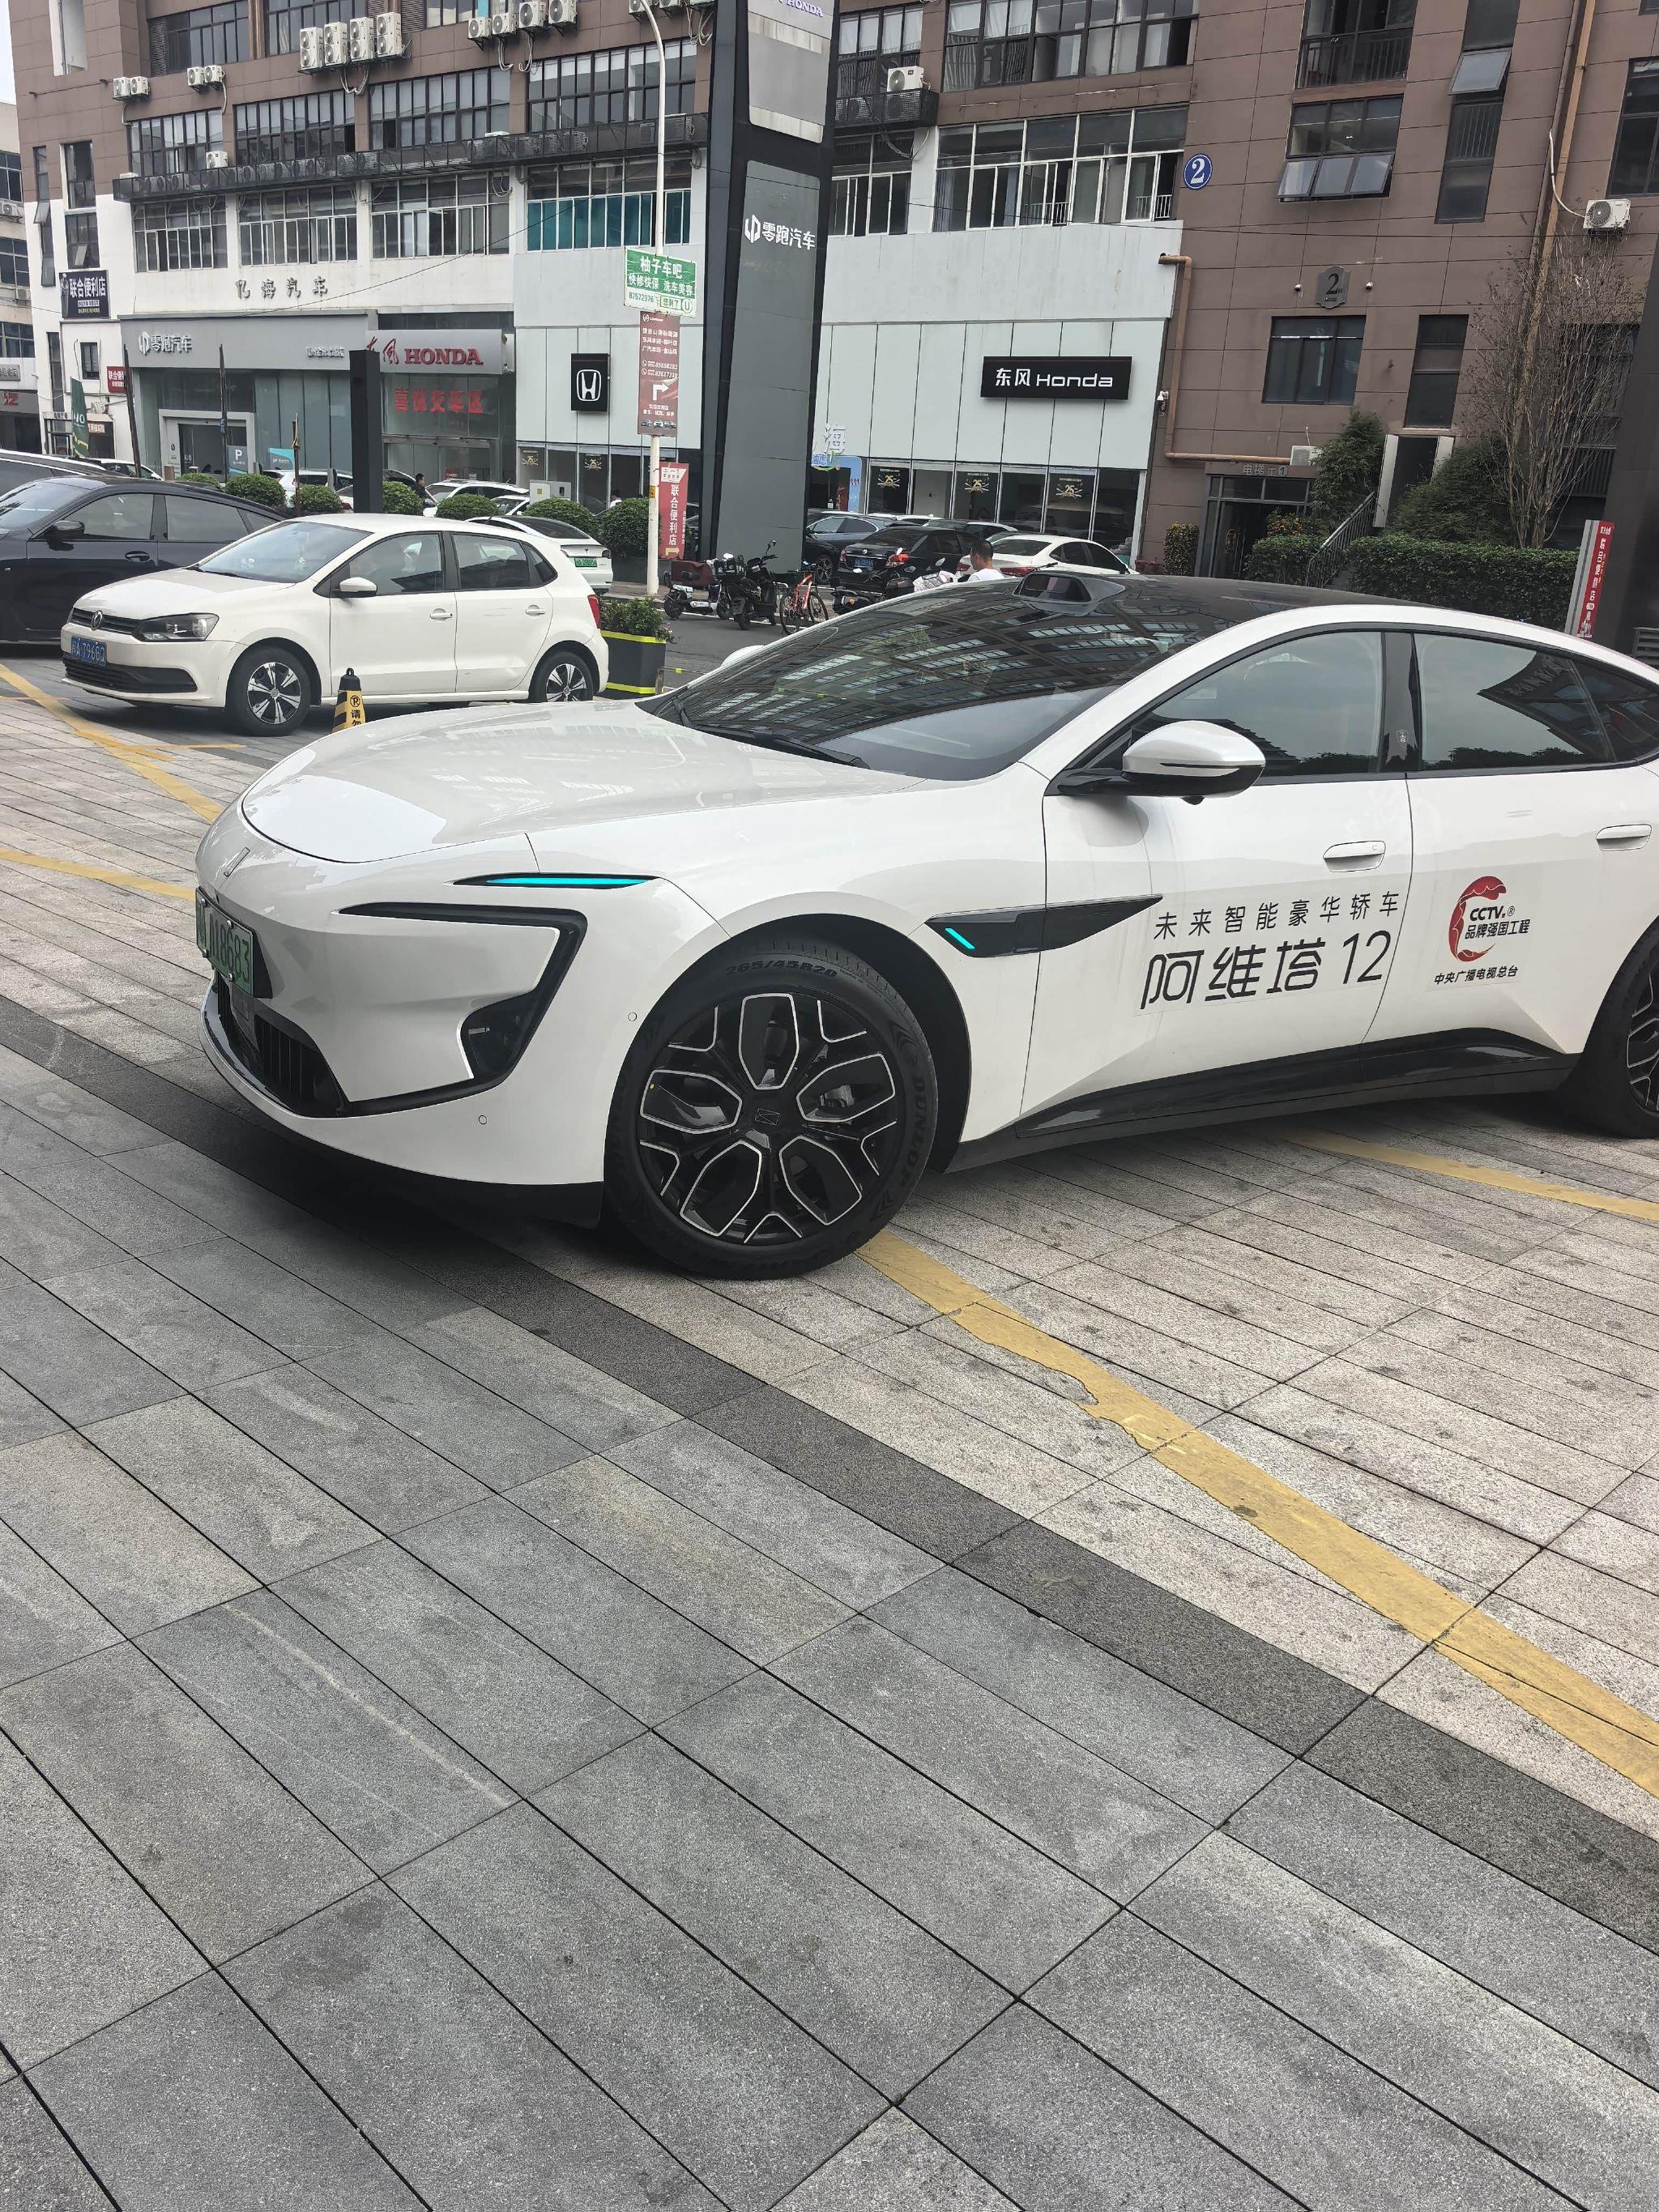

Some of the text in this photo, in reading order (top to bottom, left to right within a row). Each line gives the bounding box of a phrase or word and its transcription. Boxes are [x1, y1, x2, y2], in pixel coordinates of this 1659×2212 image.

[786, 0, 823, 17] HONDA
[1191, 158, 1205, 184] 2
[762, 221, 816, 250] 零跑汽车
[640, 255, 683, 279] 柚子车吧
[69, 276, 106, 298] 联合便利店
[235, 275, 328, 300] 亿海汽车
[628, 273, 693, 296] 快修快保 洗车美容
[1326, 273, 1339, 295] 2
[150, 335, 193, 353] 零跑汽车
[404, 348, 484, 365] HONDA
[995, 368, 1113, 387] 东风 Honda
[235, 450, 242, 460] P
[668, 484, 679, 546] 联合便利店
[1154, 891, 1399, 940] 未来智能豪华轿车
[1465, 919, 1531, 940] 品牌强国工程
[727, 959, 838, 978] 265/45R20
[1140, 930, 1392, 1010] 阿维塔 12
[1434, 965, 1518, 985] 中央广播电视总台
